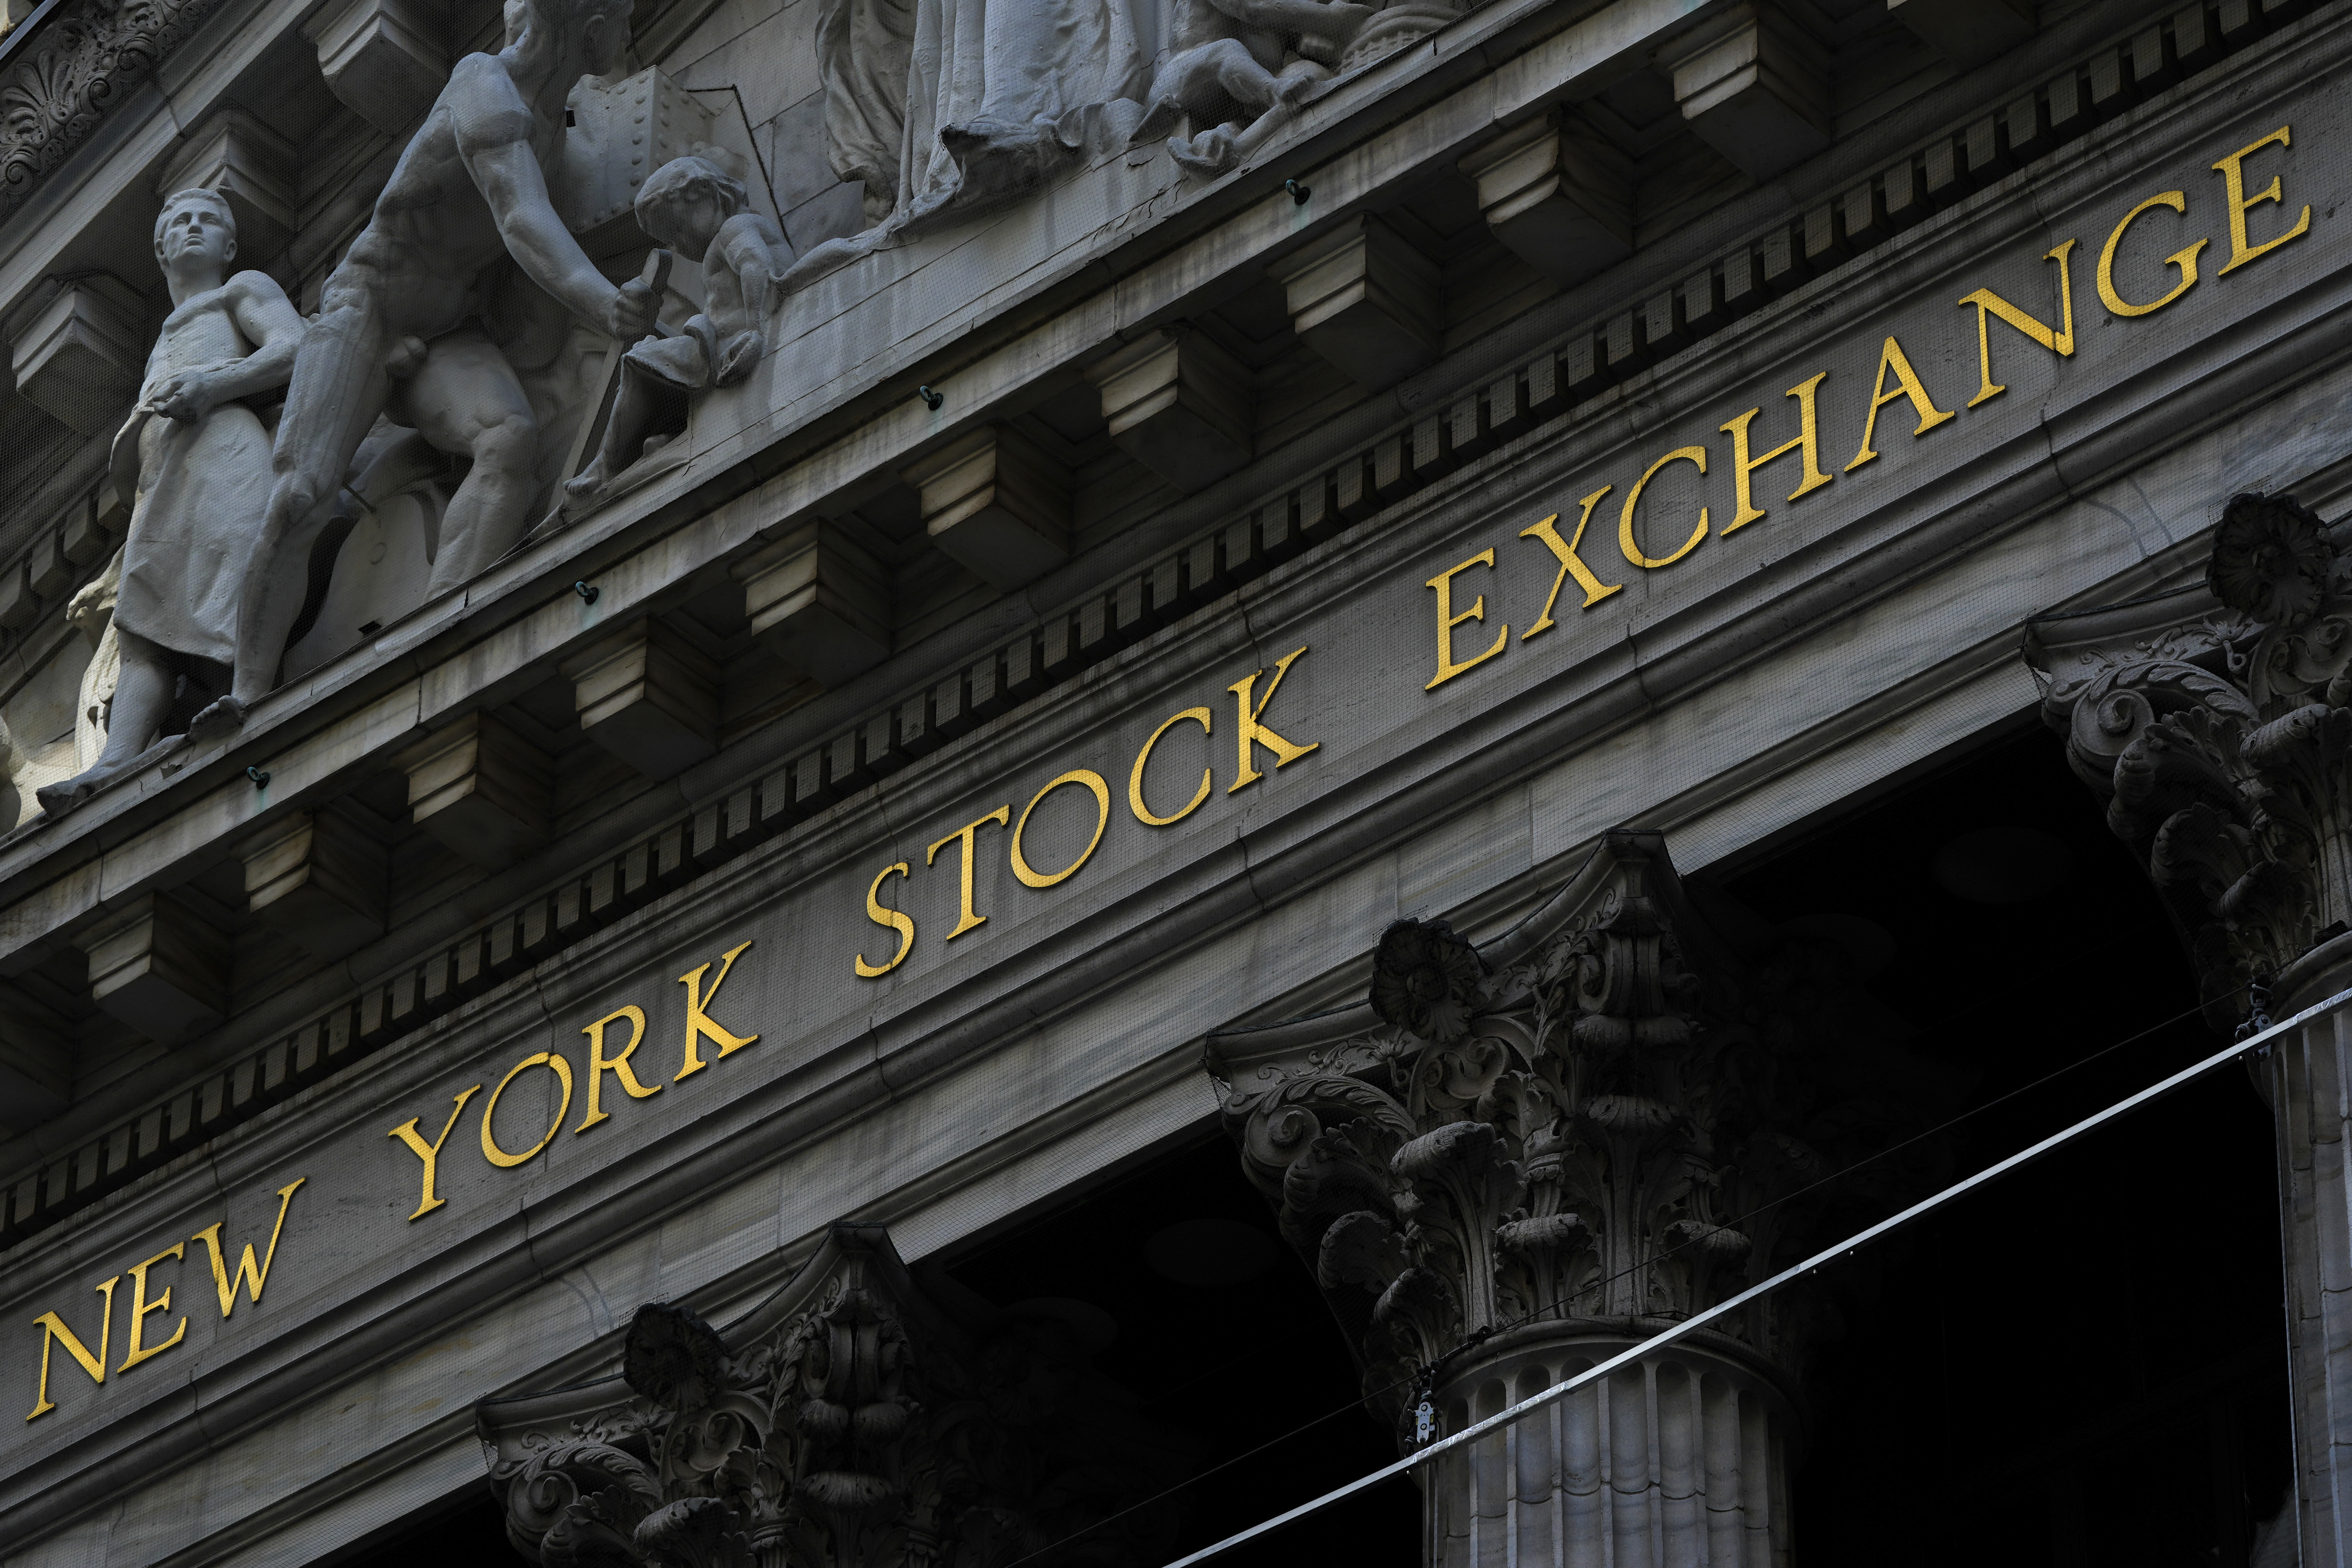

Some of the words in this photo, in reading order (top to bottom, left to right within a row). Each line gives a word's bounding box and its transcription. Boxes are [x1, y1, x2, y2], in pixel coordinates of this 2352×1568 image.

[26, 1177, 305, 1421] NEW
[388, 940, 758, 1221] YORK
[855, 646, 1319, 977] STOCK
[1425, 125, 2310, 690] EXCHANGE
